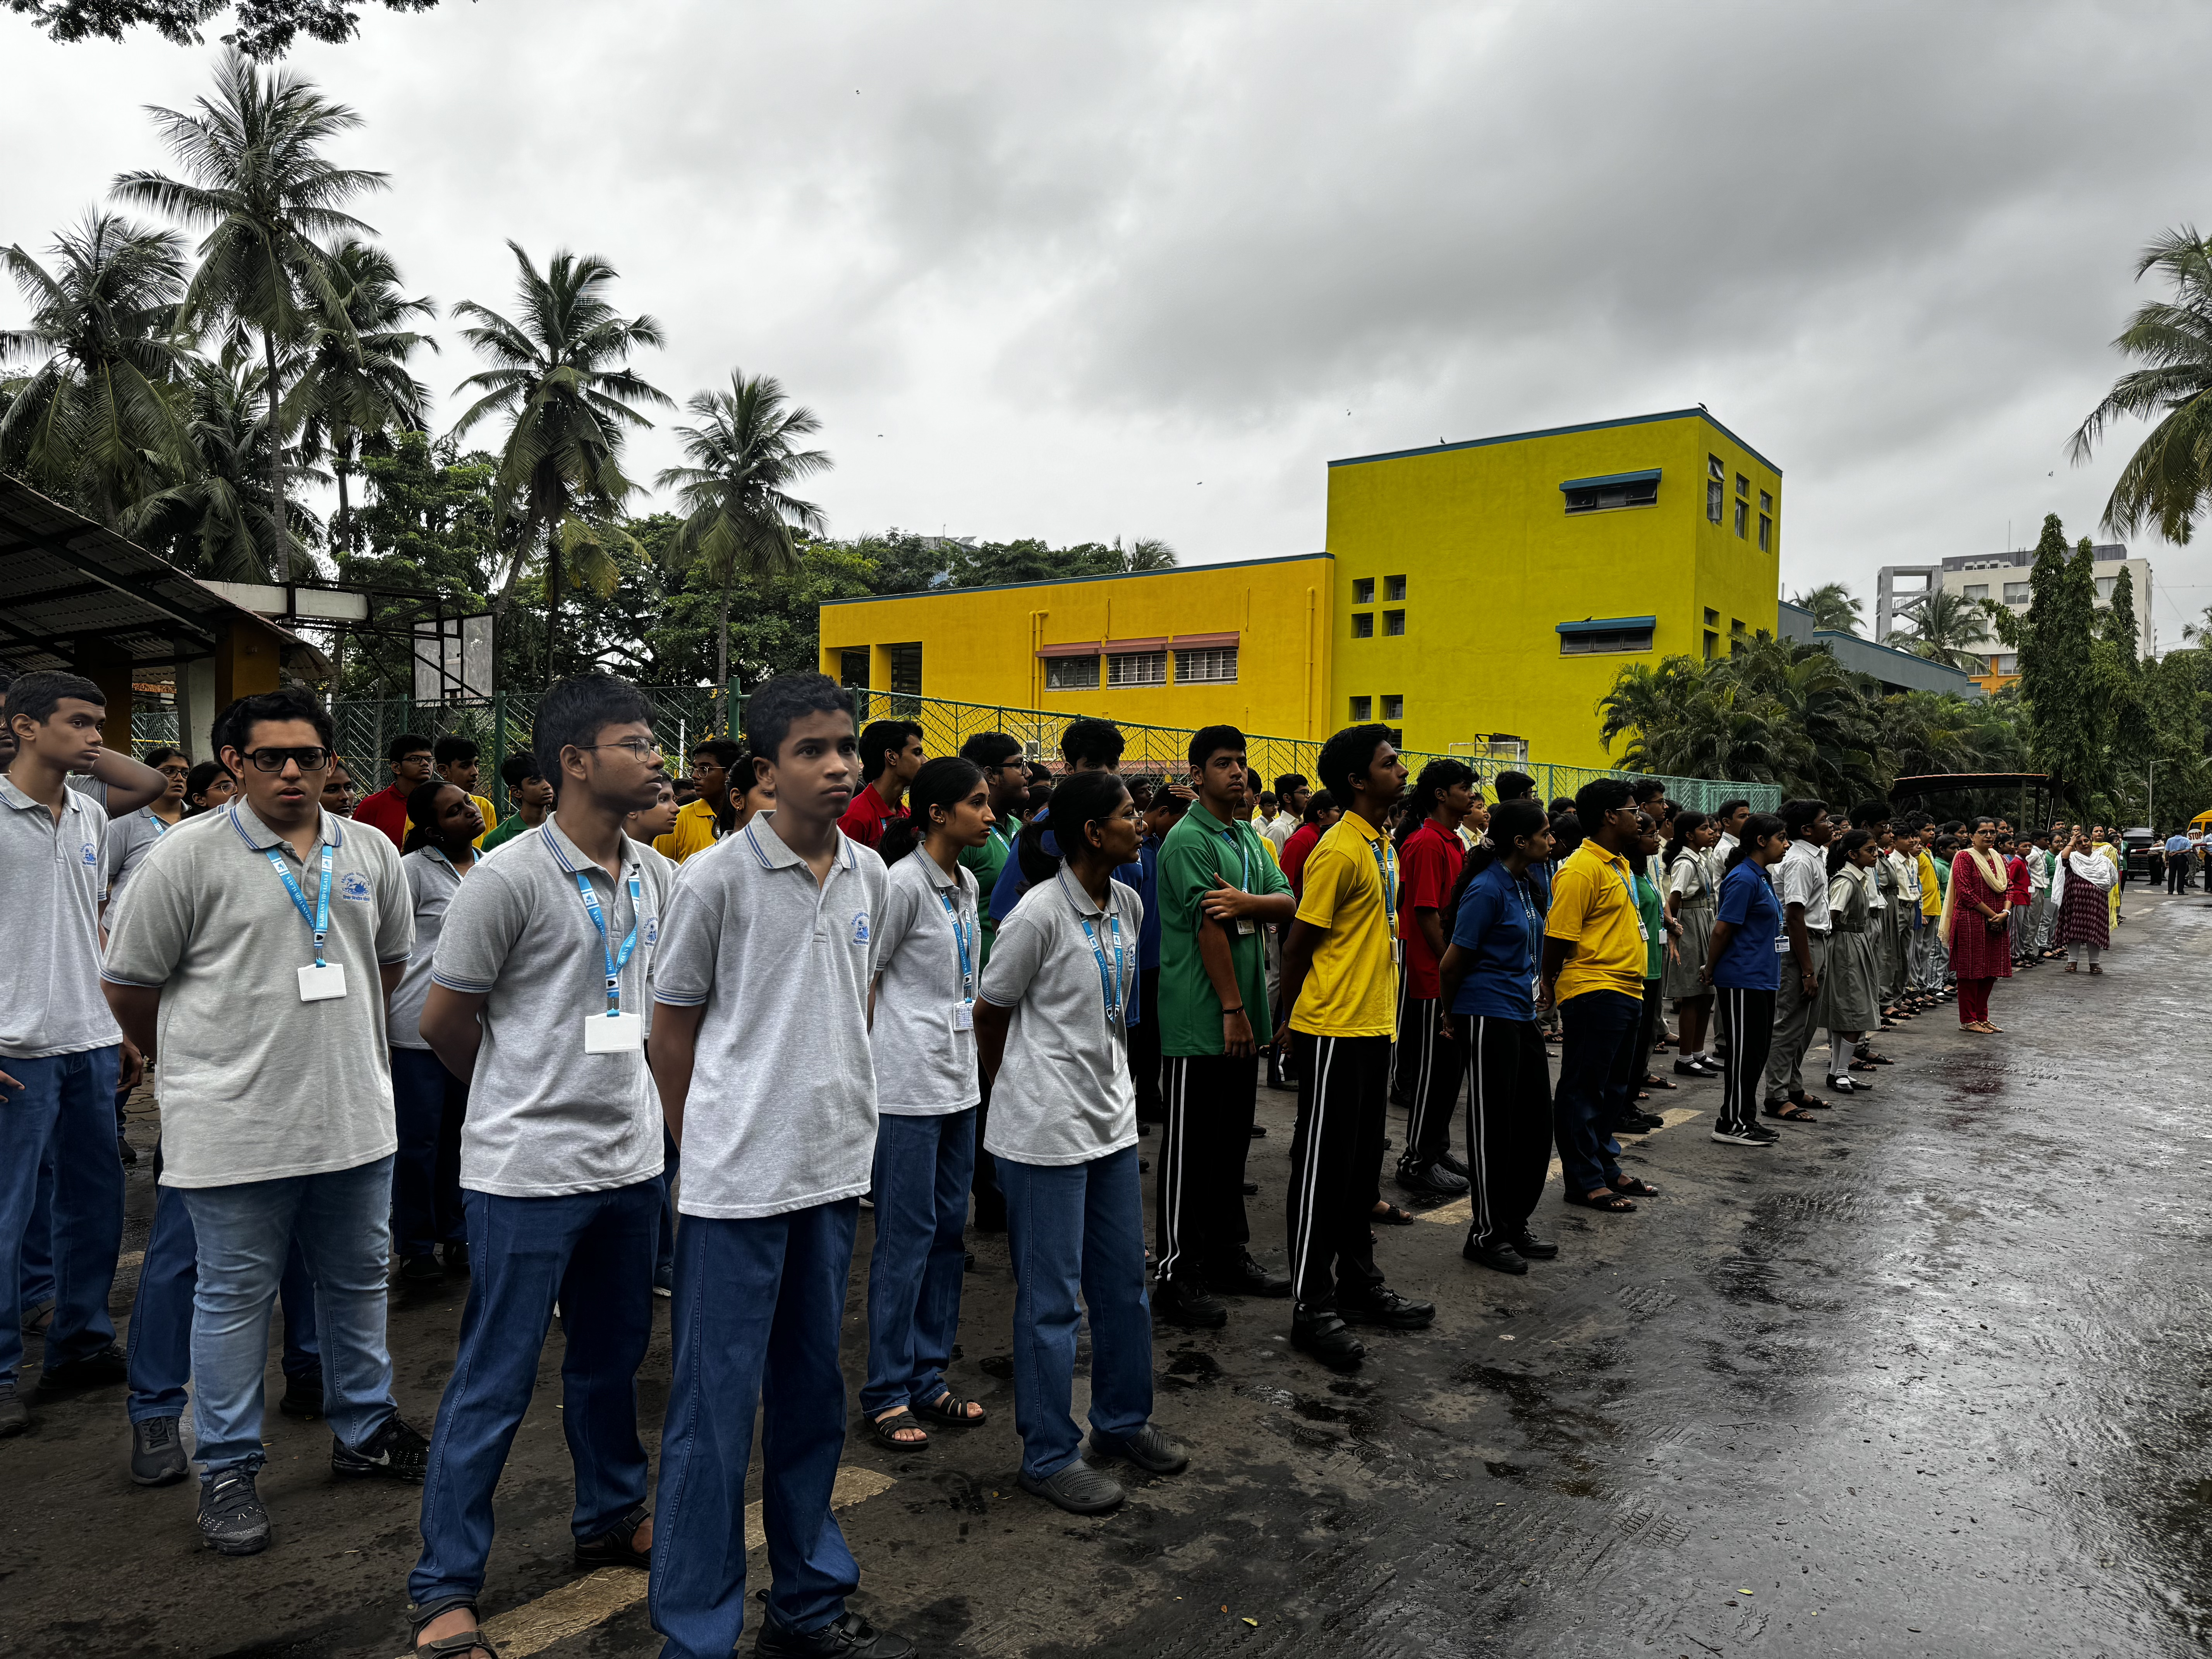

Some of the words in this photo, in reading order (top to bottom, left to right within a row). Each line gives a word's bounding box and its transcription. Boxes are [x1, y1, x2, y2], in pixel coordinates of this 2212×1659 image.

[2188, 831, 2202, 840] STOP
[286, 876, 303, 905] VIDYALAYA
[1097, 953, 1107, 980] VIDYALAYA
